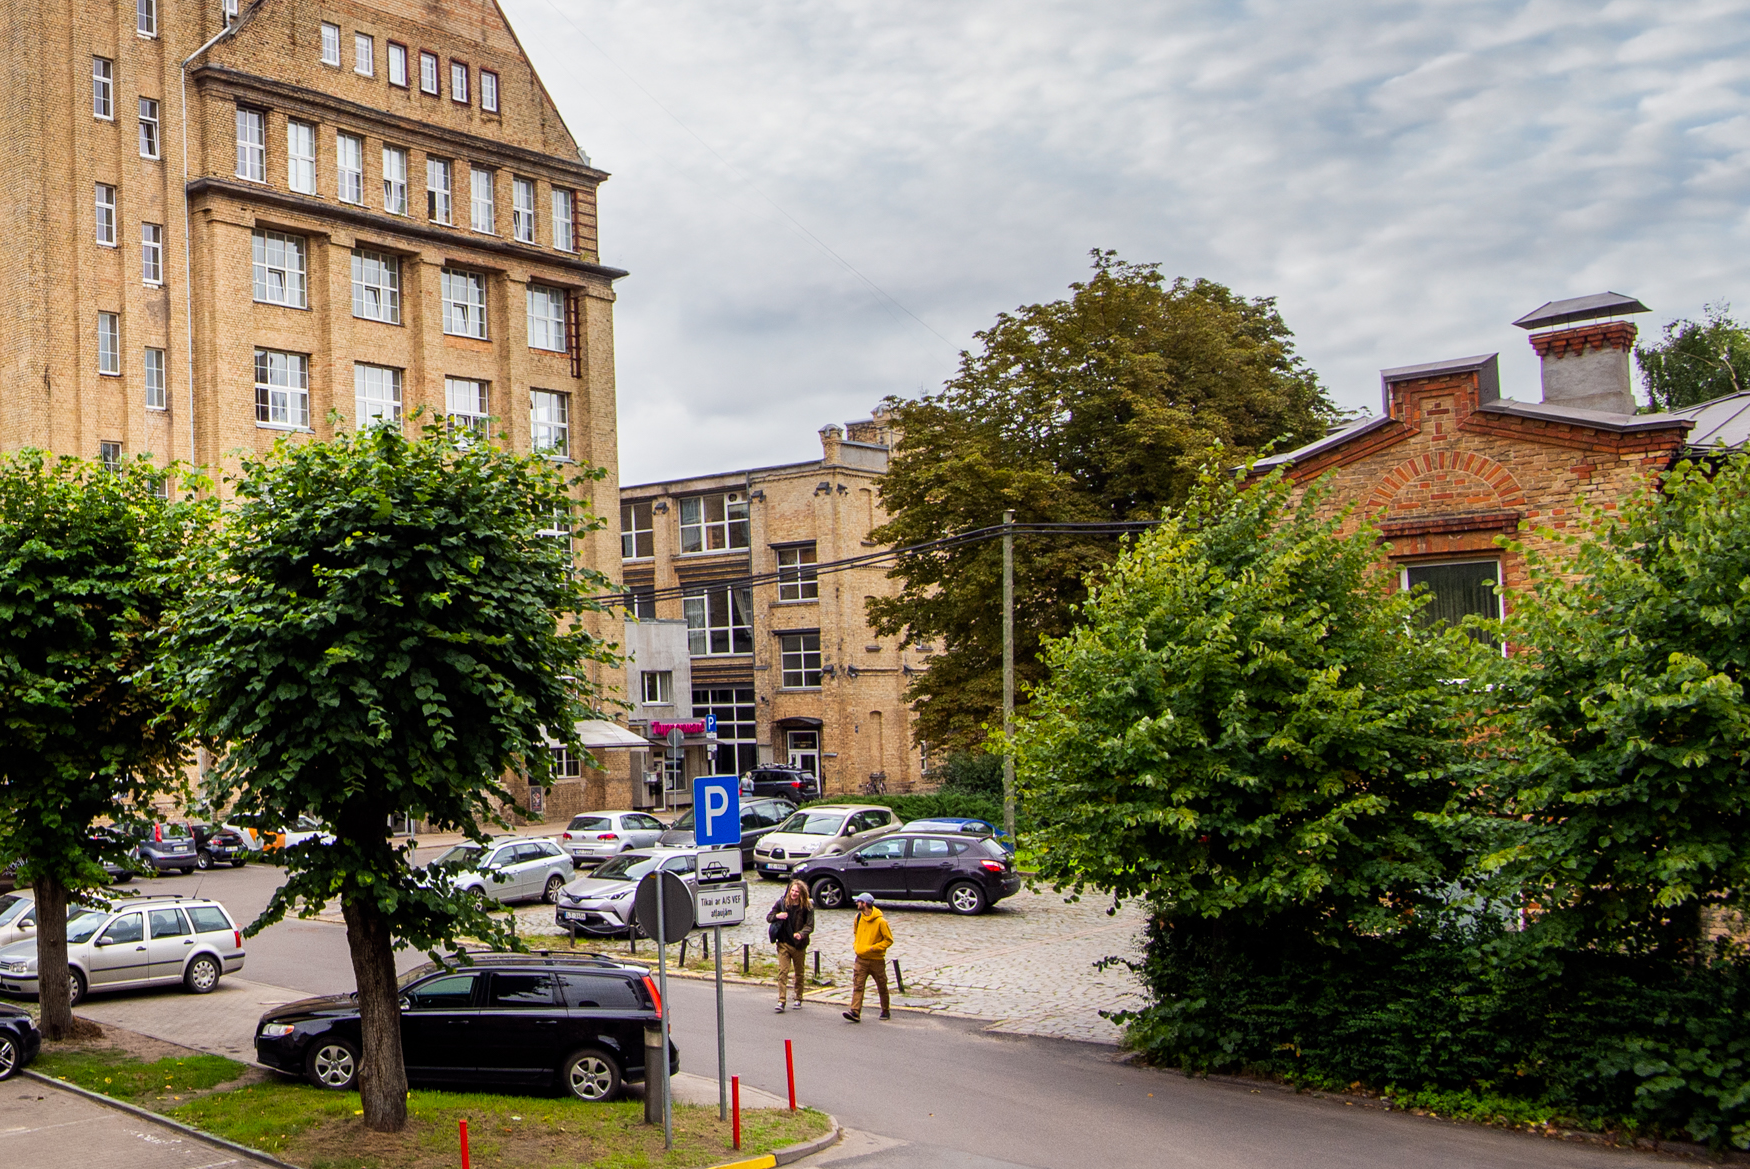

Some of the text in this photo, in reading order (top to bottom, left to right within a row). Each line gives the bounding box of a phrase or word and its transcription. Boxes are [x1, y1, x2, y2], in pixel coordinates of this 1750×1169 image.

[709, 716, 715, 730] P
[704, 785, 729, 837] P
[701, 897, 714, 907] Tikai
[722, 895, 731, 905] A/S
[731, 894, 741, 903] VEF
